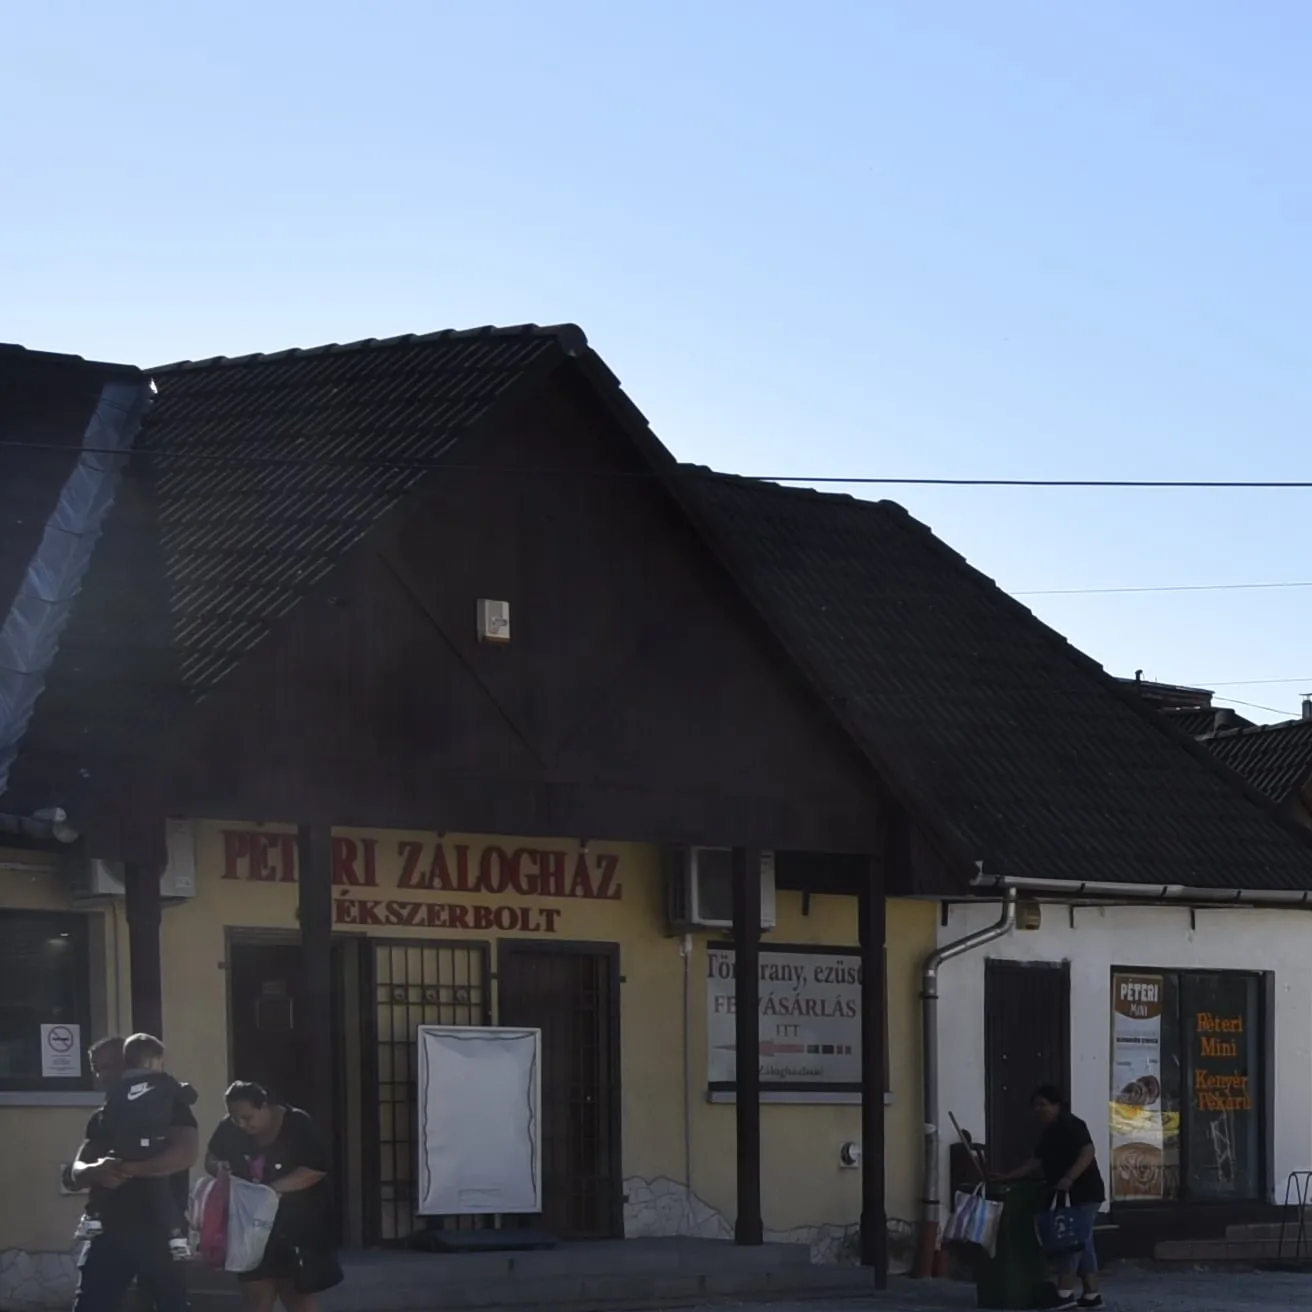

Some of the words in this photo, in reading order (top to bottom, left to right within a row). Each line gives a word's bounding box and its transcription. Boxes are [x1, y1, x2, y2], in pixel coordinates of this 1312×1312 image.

[397, 832, 622, 900] ZÁLOGHÁZ
[333, 889, 561, 933] ÉKSZERBOLT
[759, 962, 808, 992] rany,
[1120, 978, 1159, 1003] PÉTERI
[776, 1023, 801, 1038] ITT
[1200, 1036, 1237, 1057] Mini
